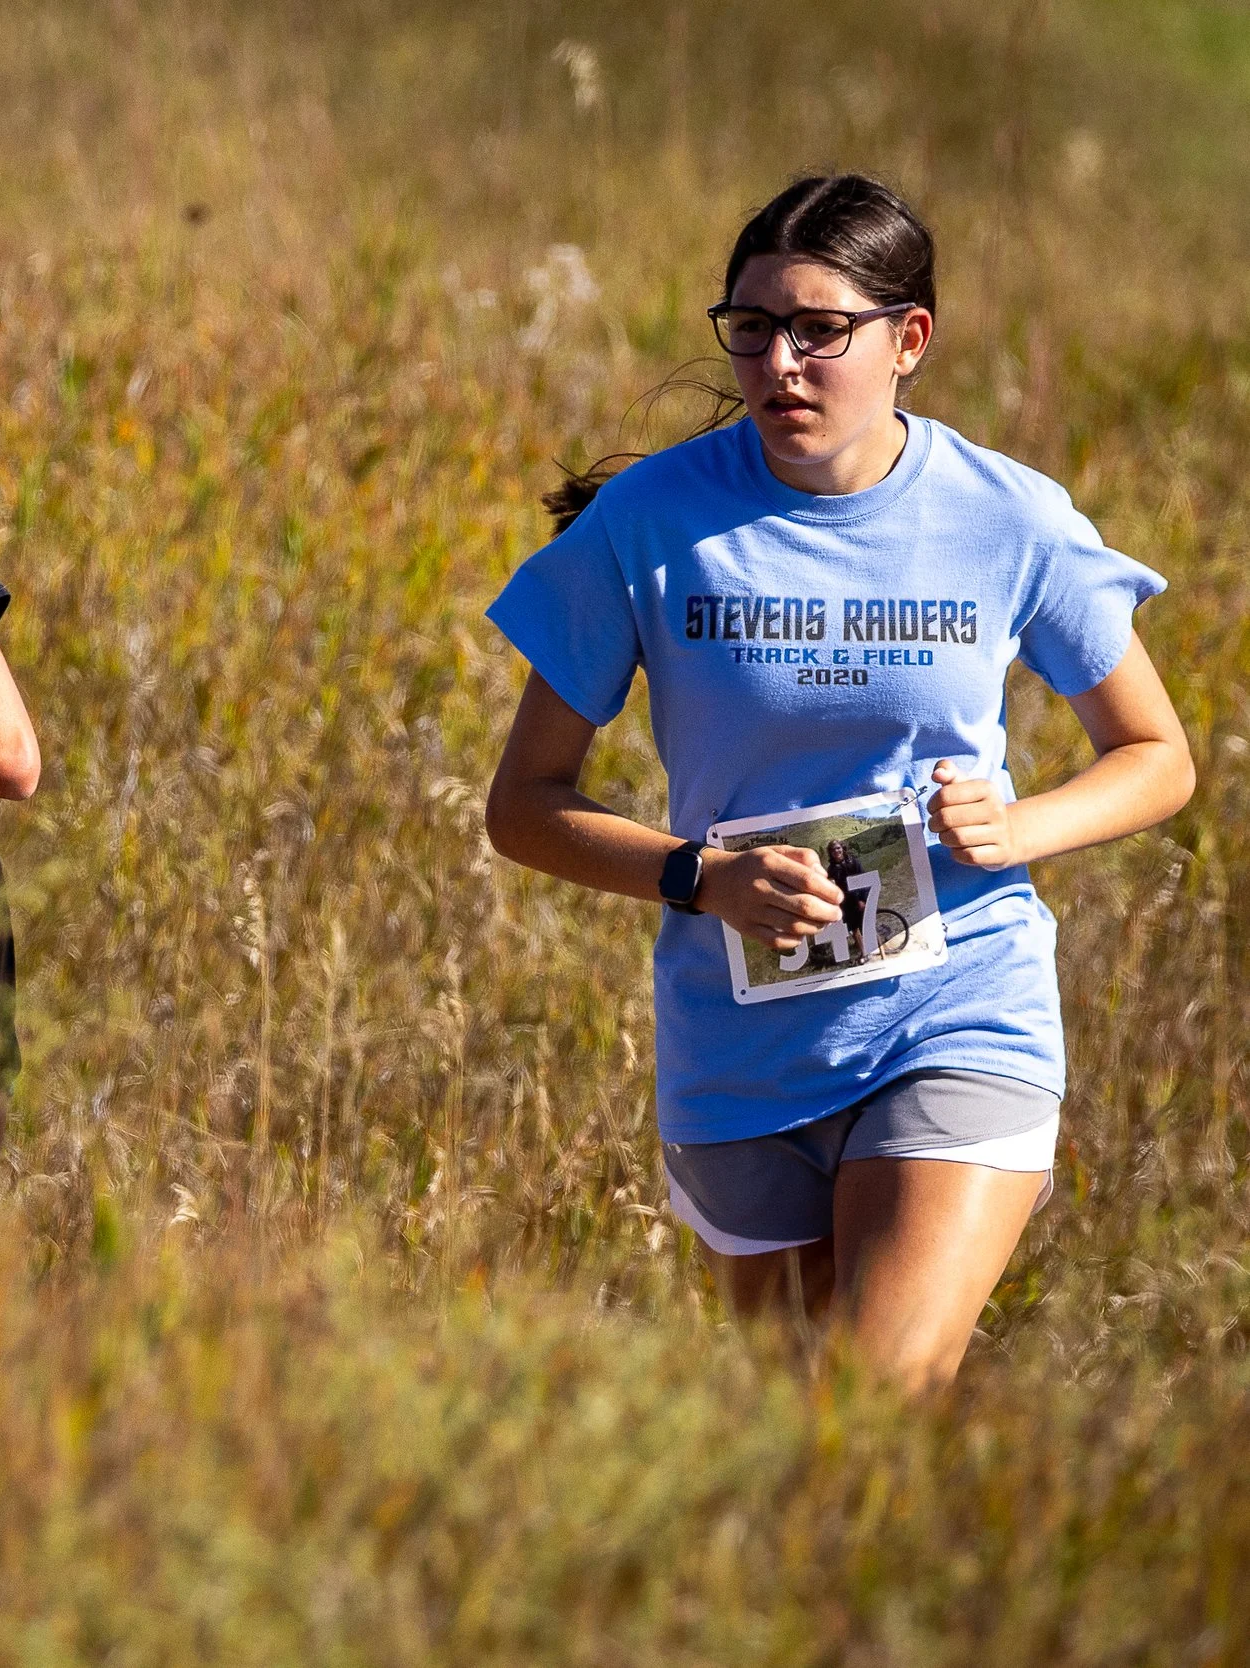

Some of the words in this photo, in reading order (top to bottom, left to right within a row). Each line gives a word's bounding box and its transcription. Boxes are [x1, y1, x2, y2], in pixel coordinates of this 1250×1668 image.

[685, 595, 826, 640] STEVENS
[843, 598, 977, 644] RAIDERS
[730, 647, 819, 664] TRACK
[832, 648, 849, 664] &
[863, 648, 933, 666] FIELD
[797, 668, 868, 685] 2020
